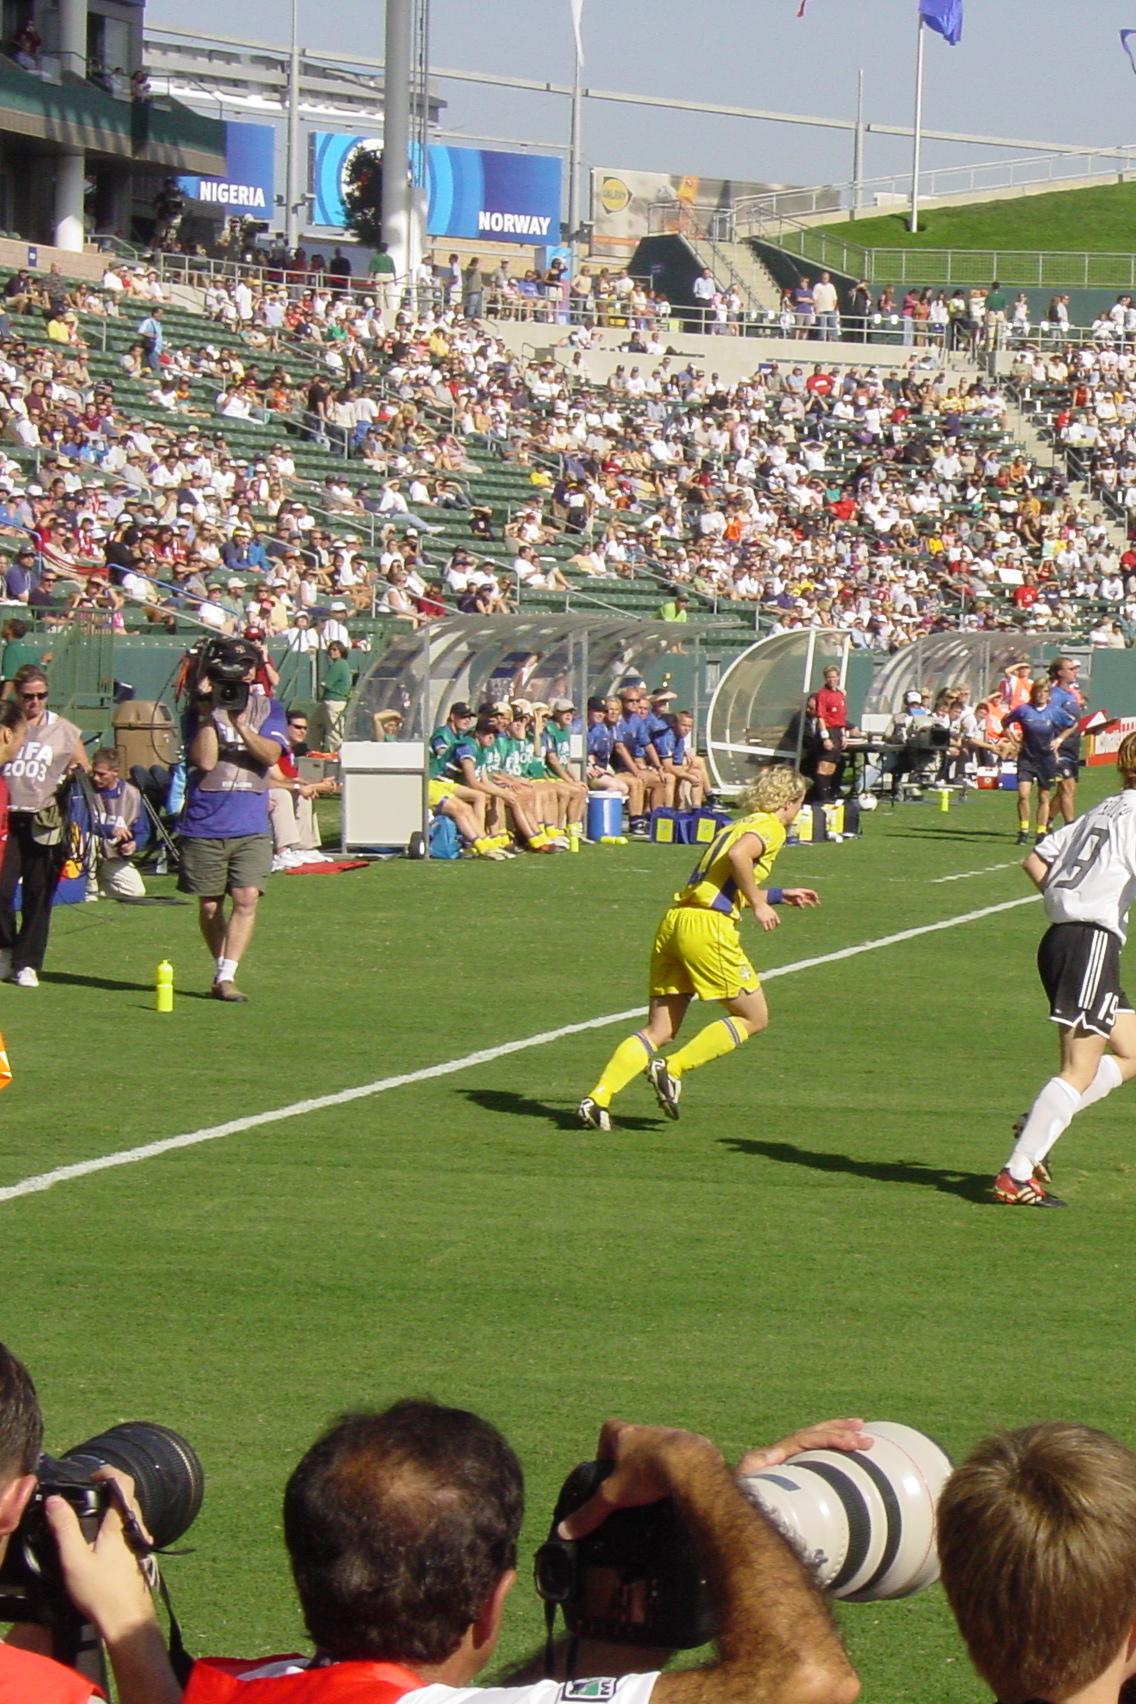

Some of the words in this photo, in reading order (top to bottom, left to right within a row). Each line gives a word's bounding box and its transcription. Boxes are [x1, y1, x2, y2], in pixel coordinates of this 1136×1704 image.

[199, 181, 266, 208] NIGERIA
[478, 211, 551, 236] NORWAY
[16, 741, 54, 767] IFA
[3, 759, 48, 783] 2003
[1097, 992, 1119, 1026] 19
